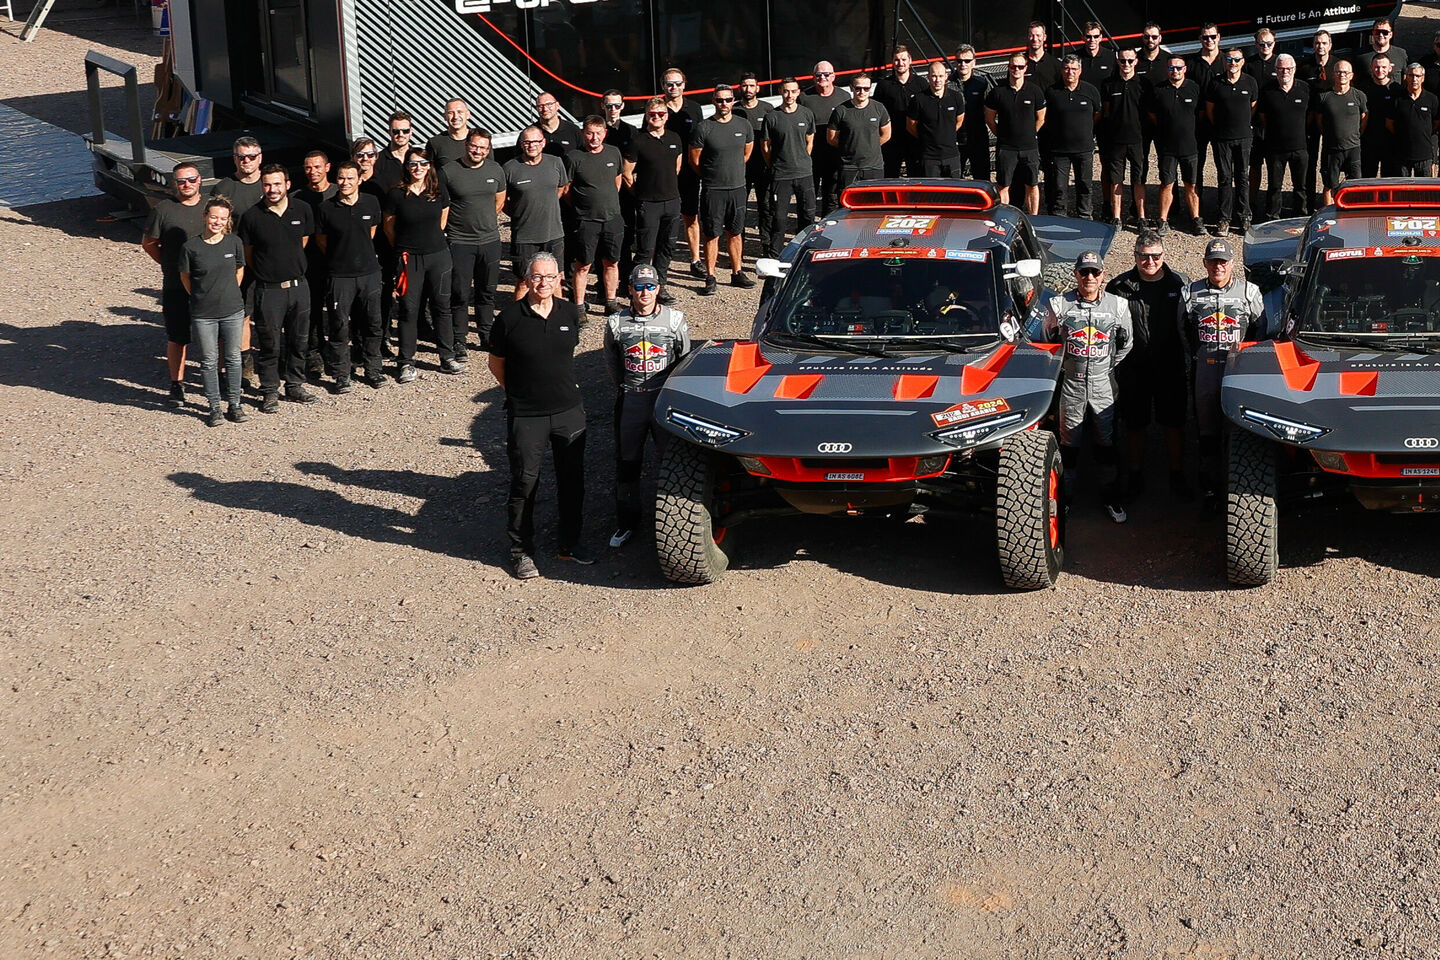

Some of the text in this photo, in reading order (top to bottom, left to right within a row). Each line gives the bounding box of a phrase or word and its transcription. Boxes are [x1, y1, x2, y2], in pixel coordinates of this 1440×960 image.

[1265, 13, 1296, 24] Future
[1298, 11, 1306, 20] Is
[1308, 10, 1322, 19] An
[1323, 3, 1361, 18] Attitude
[1390, 220, 1437, 230] 204
[815, 250, 850, 259] MOTUL
[947, 251, 983, 259] aramco
[1328, 249, 1364, 258] MOTUL
[1200, 329, 1240, 342] Red Bull
[1067, 343, 1109, 358] Red Bull
[624, 357, 668, 372] Red Bull
[977, 399, 1004, 410] 2024
